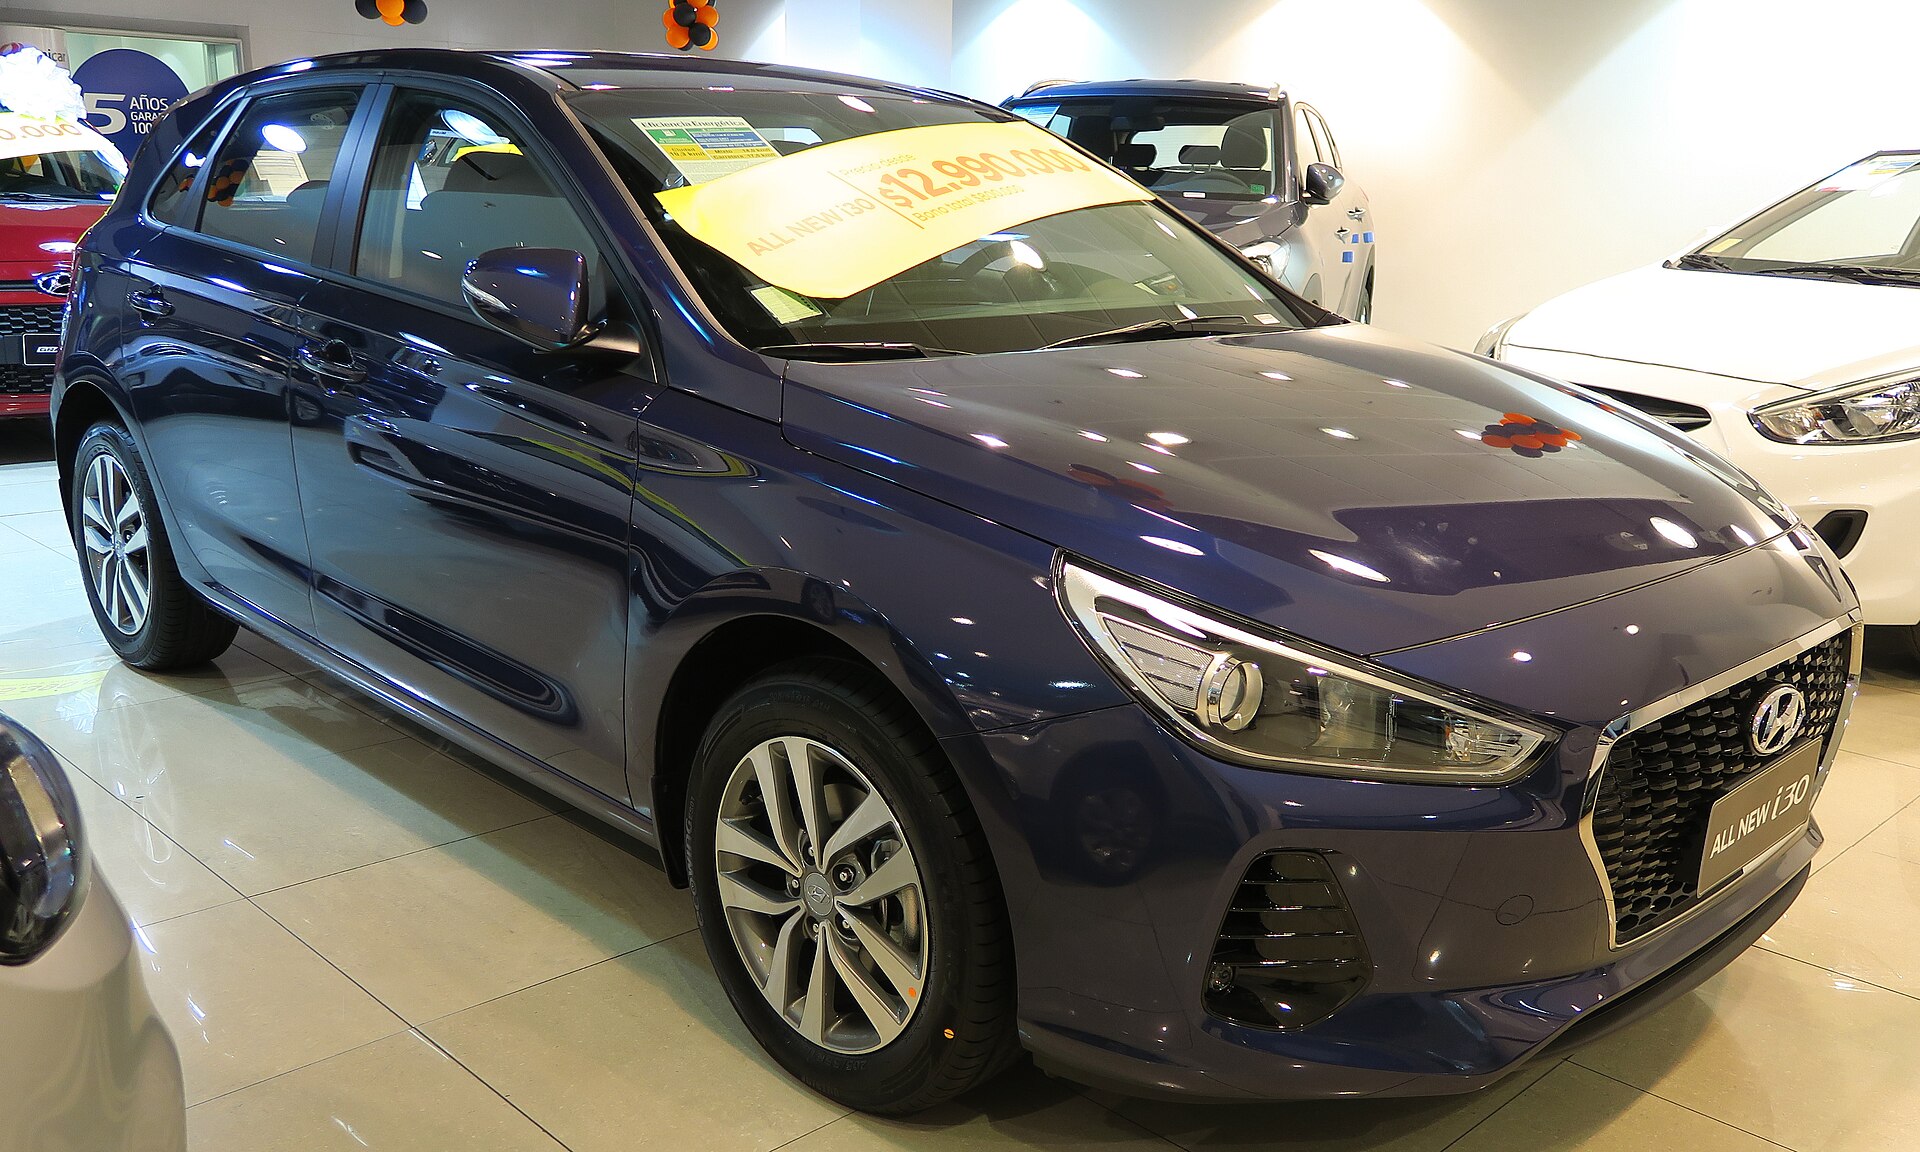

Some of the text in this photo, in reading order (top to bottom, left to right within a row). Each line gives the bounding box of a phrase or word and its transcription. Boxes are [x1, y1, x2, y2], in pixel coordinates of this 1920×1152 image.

[83, 92, 127, 135] 5
[878, 148, 1092, 209] $12.990.000
[911, 205, 950, 222] Bono
[948, 194, 975, 211] total
[747, 198, 876, 257] ALL NEW i30
[1709, 774, 1810, 859] ALL NEW i30
